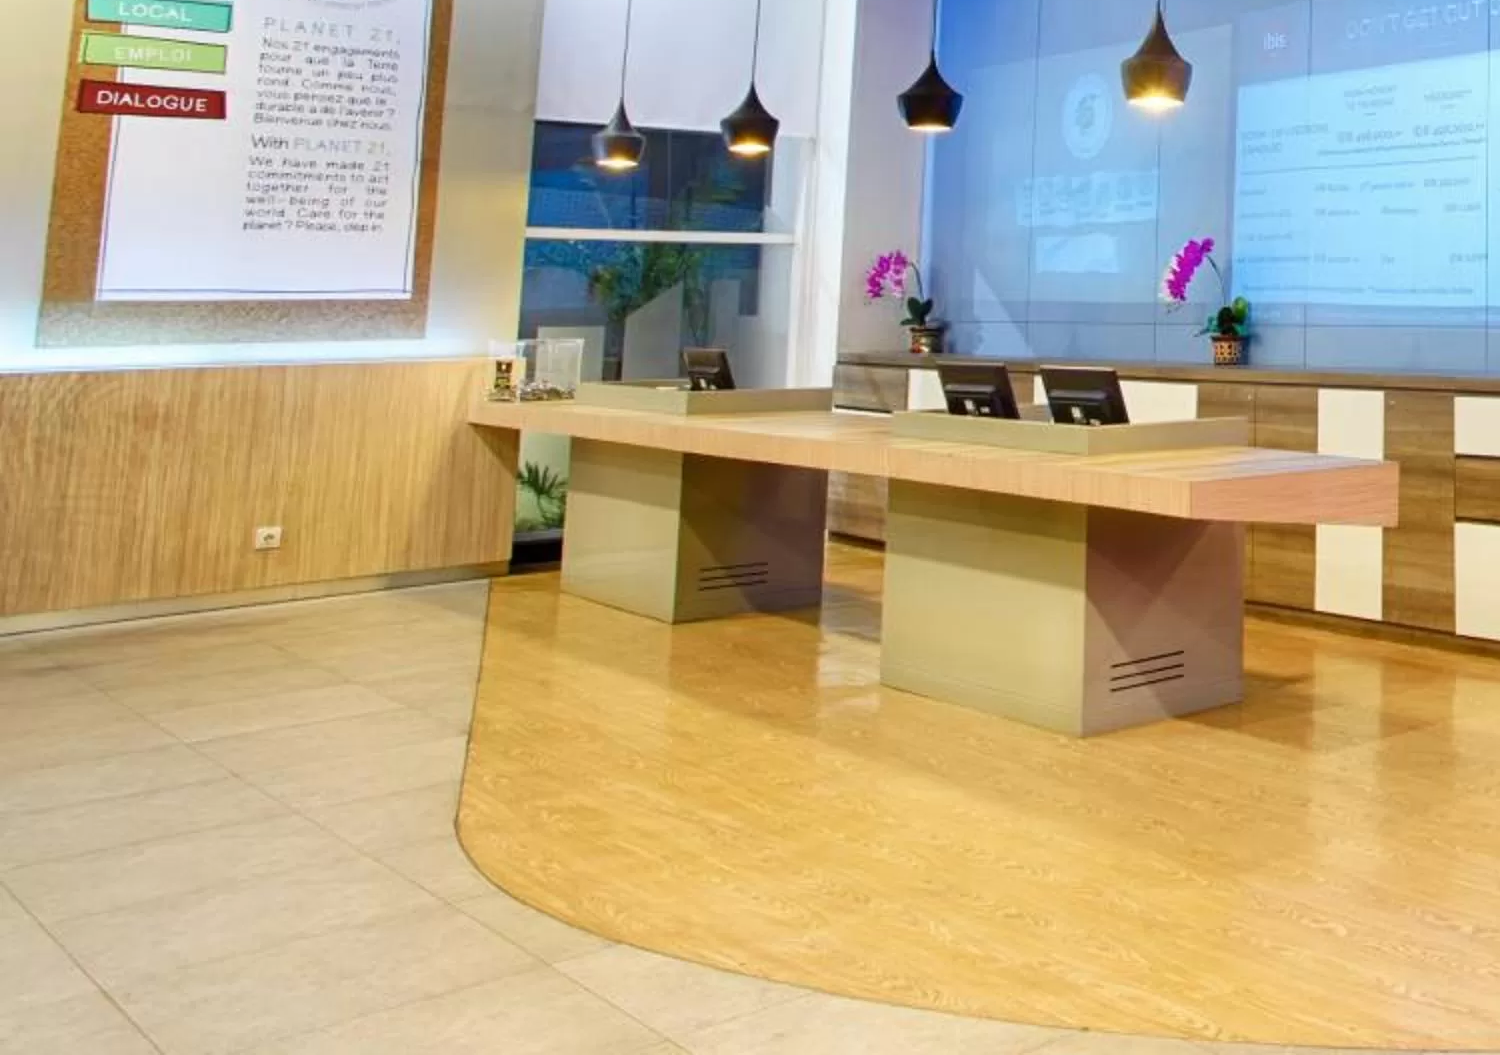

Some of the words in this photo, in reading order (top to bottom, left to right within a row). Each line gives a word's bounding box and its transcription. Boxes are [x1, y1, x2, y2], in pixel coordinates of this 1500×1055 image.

[118, 2, 193, 22] LOCAL
[263, 16, 354, 37] PLANET
[114, 47, 193, 62] EMPLOI
[96, 90, 209, 112] DIALOGUE
[251, 133, 289, 149] With
[293, 137, 362, 154] PLANET
[248, 155, 272, 167] We
[282, 157, 317, 169] have
